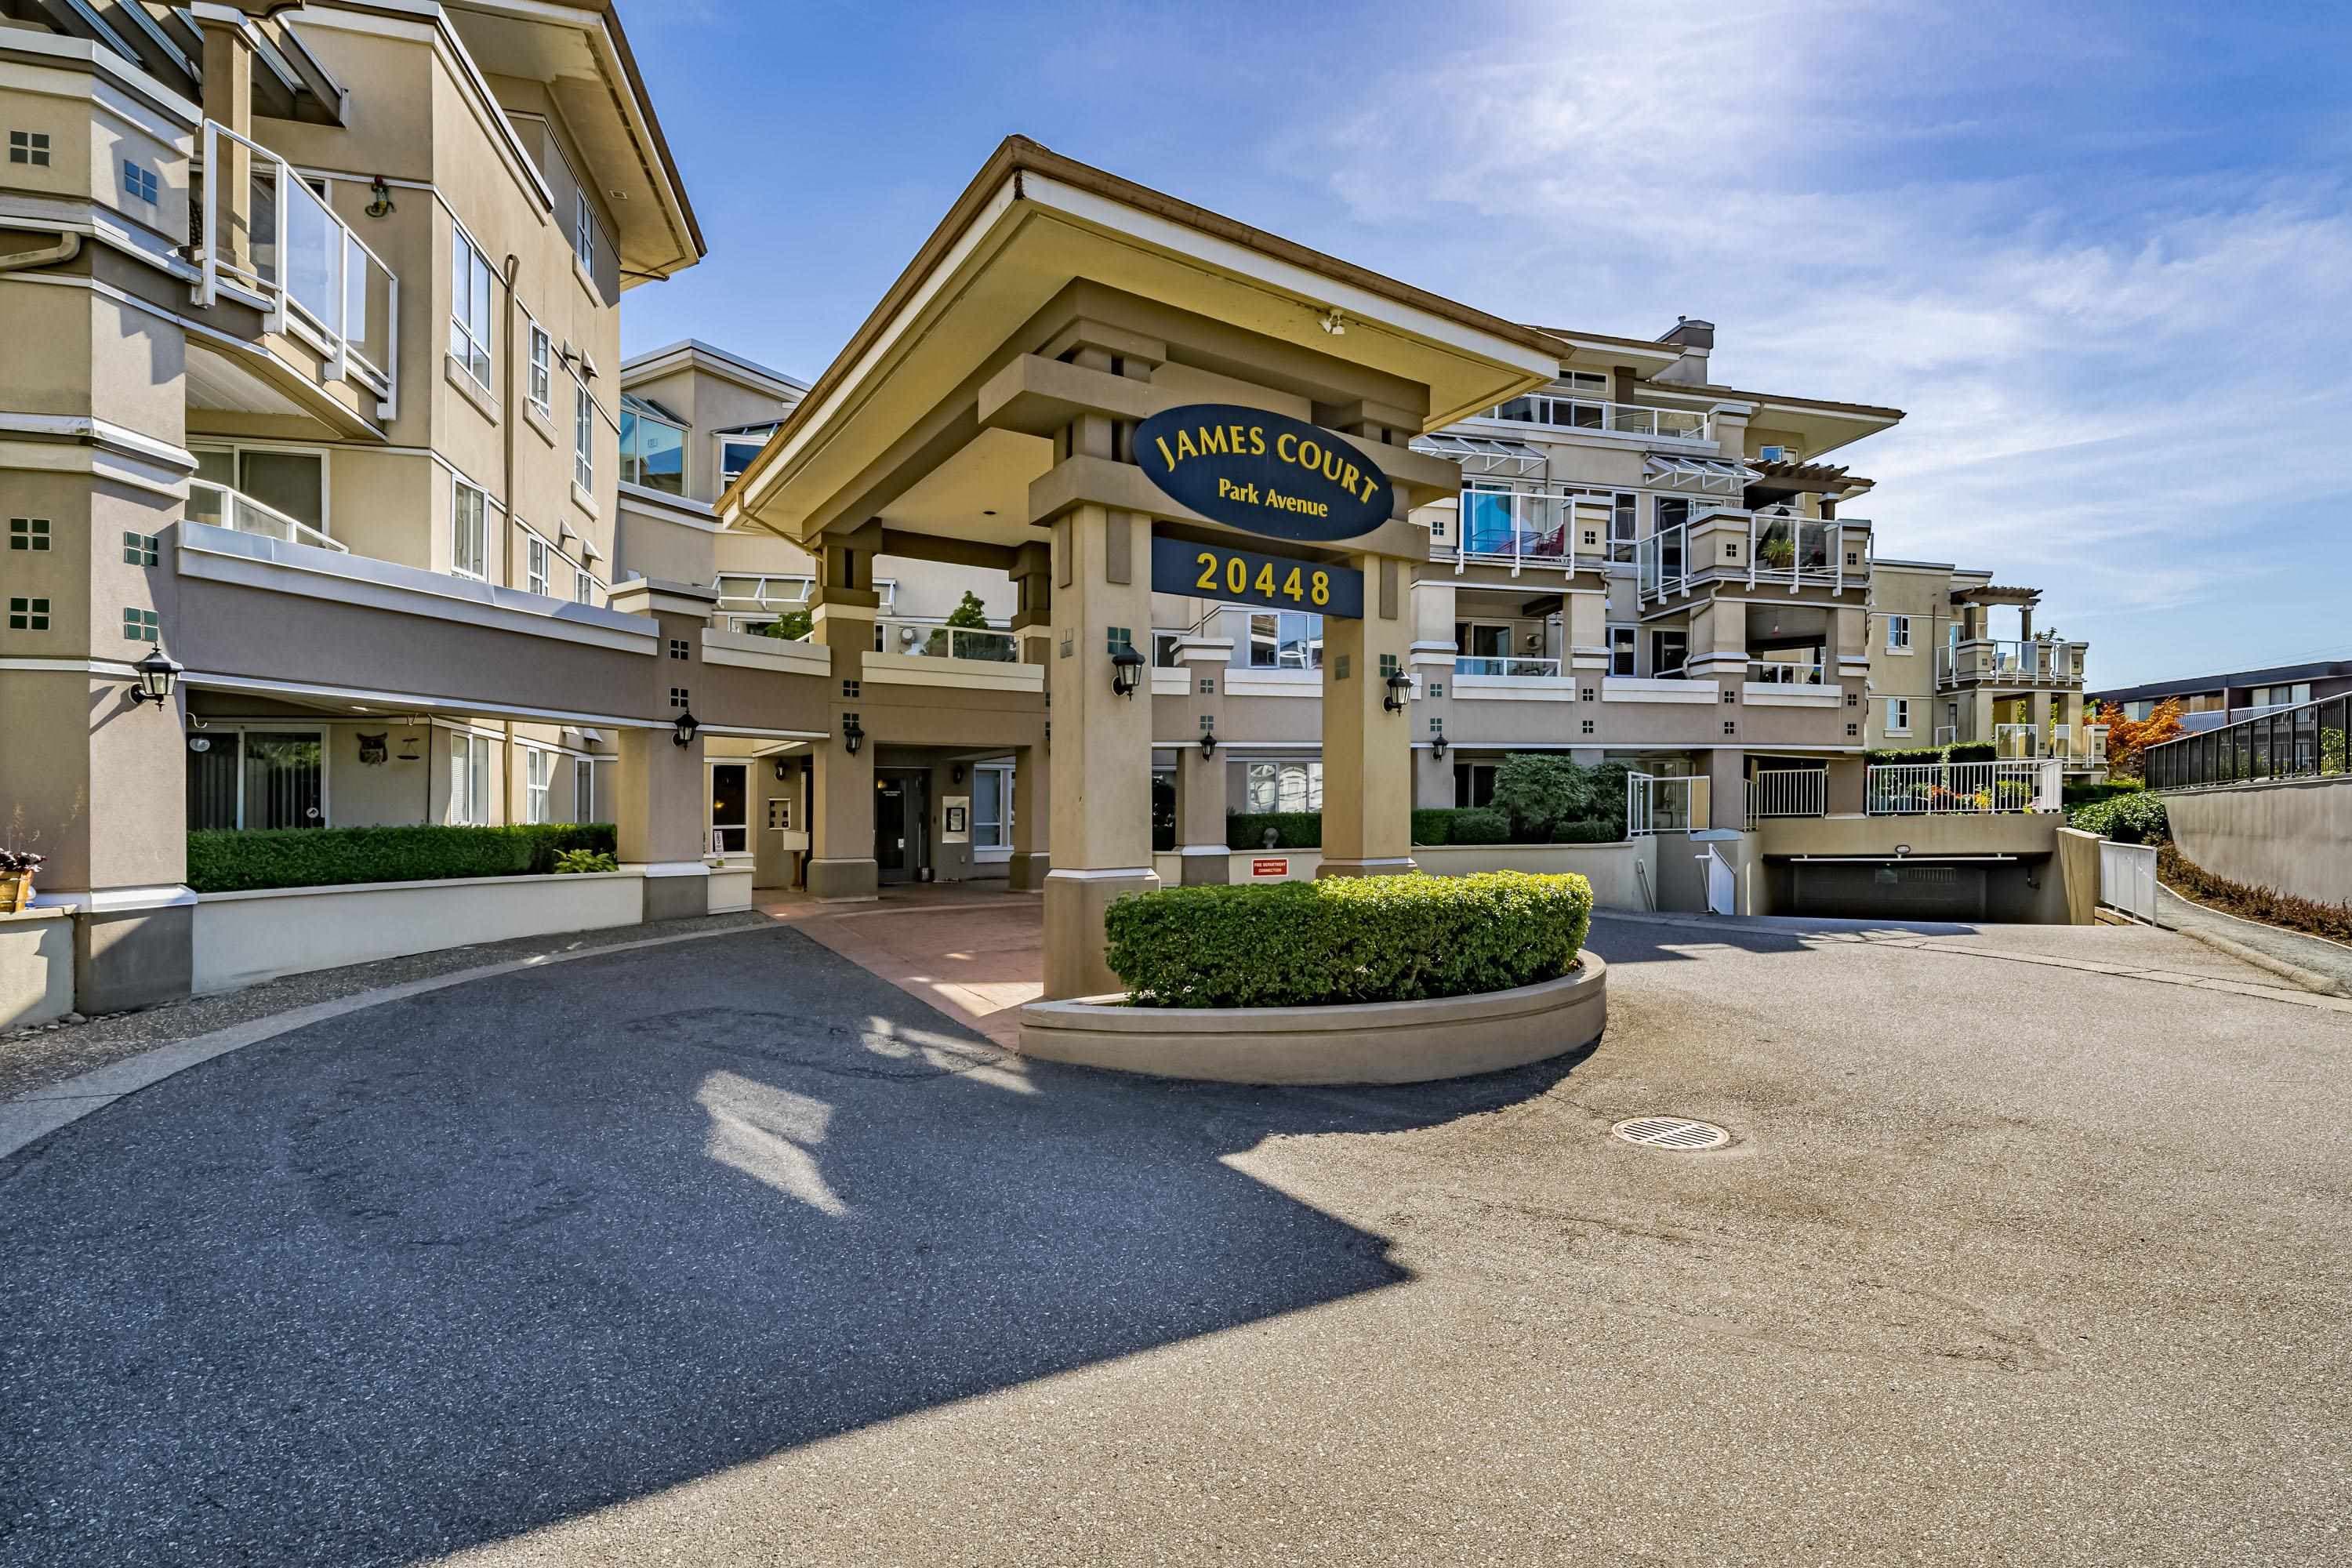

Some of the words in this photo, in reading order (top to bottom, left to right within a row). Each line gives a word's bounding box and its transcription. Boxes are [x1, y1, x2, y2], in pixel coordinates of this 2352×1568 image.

[1156, 426, 1265, 472] JAMES
[1276, 433, 1379, 505] COURT
[1219, 477, 1259, 505] Park
[1265, 488, 1328, 517] Avenue
[1196, 552, 1330, 606] 20448
